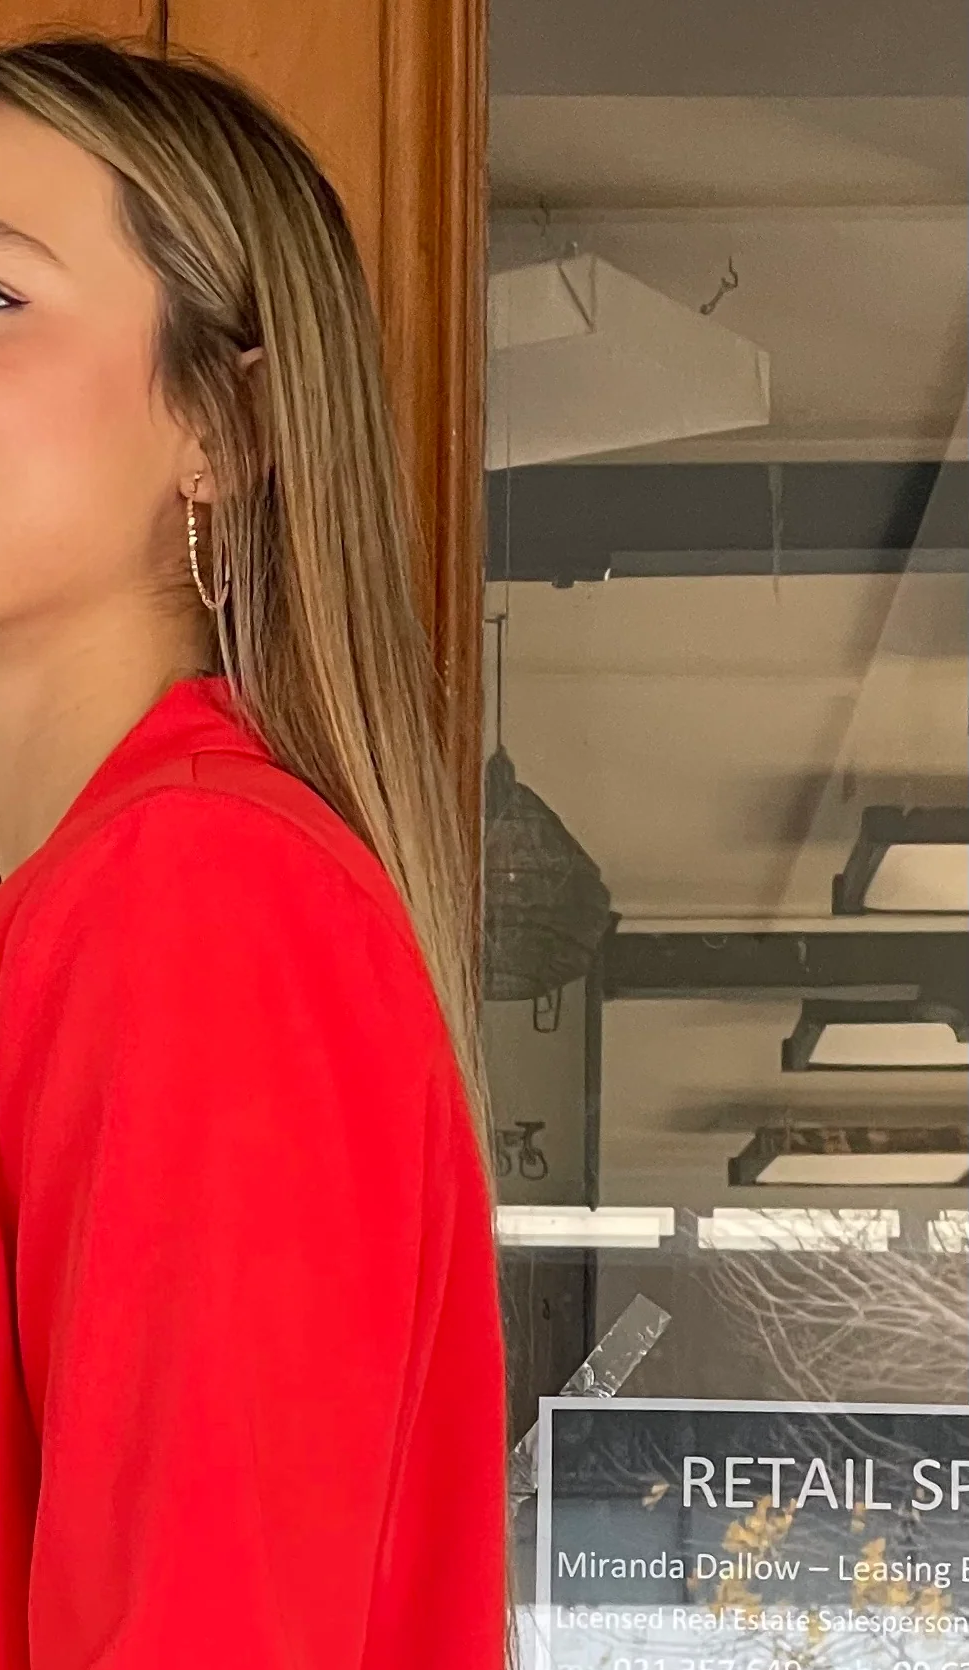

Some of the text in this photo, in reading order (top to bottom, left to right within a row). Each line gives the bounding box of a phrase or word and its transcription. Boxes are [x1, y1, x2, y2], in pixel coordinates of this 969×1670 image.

[682, 1456, 891, 1511] RETAIL
[557, 1551, 685, 1580] Miranda
[696, 1552, 801, 1581] Dallow
[838, 1555, 952, 1589] Leasing
[556, 1607, 969, 1637] Licensed Real Estate Salesperson
